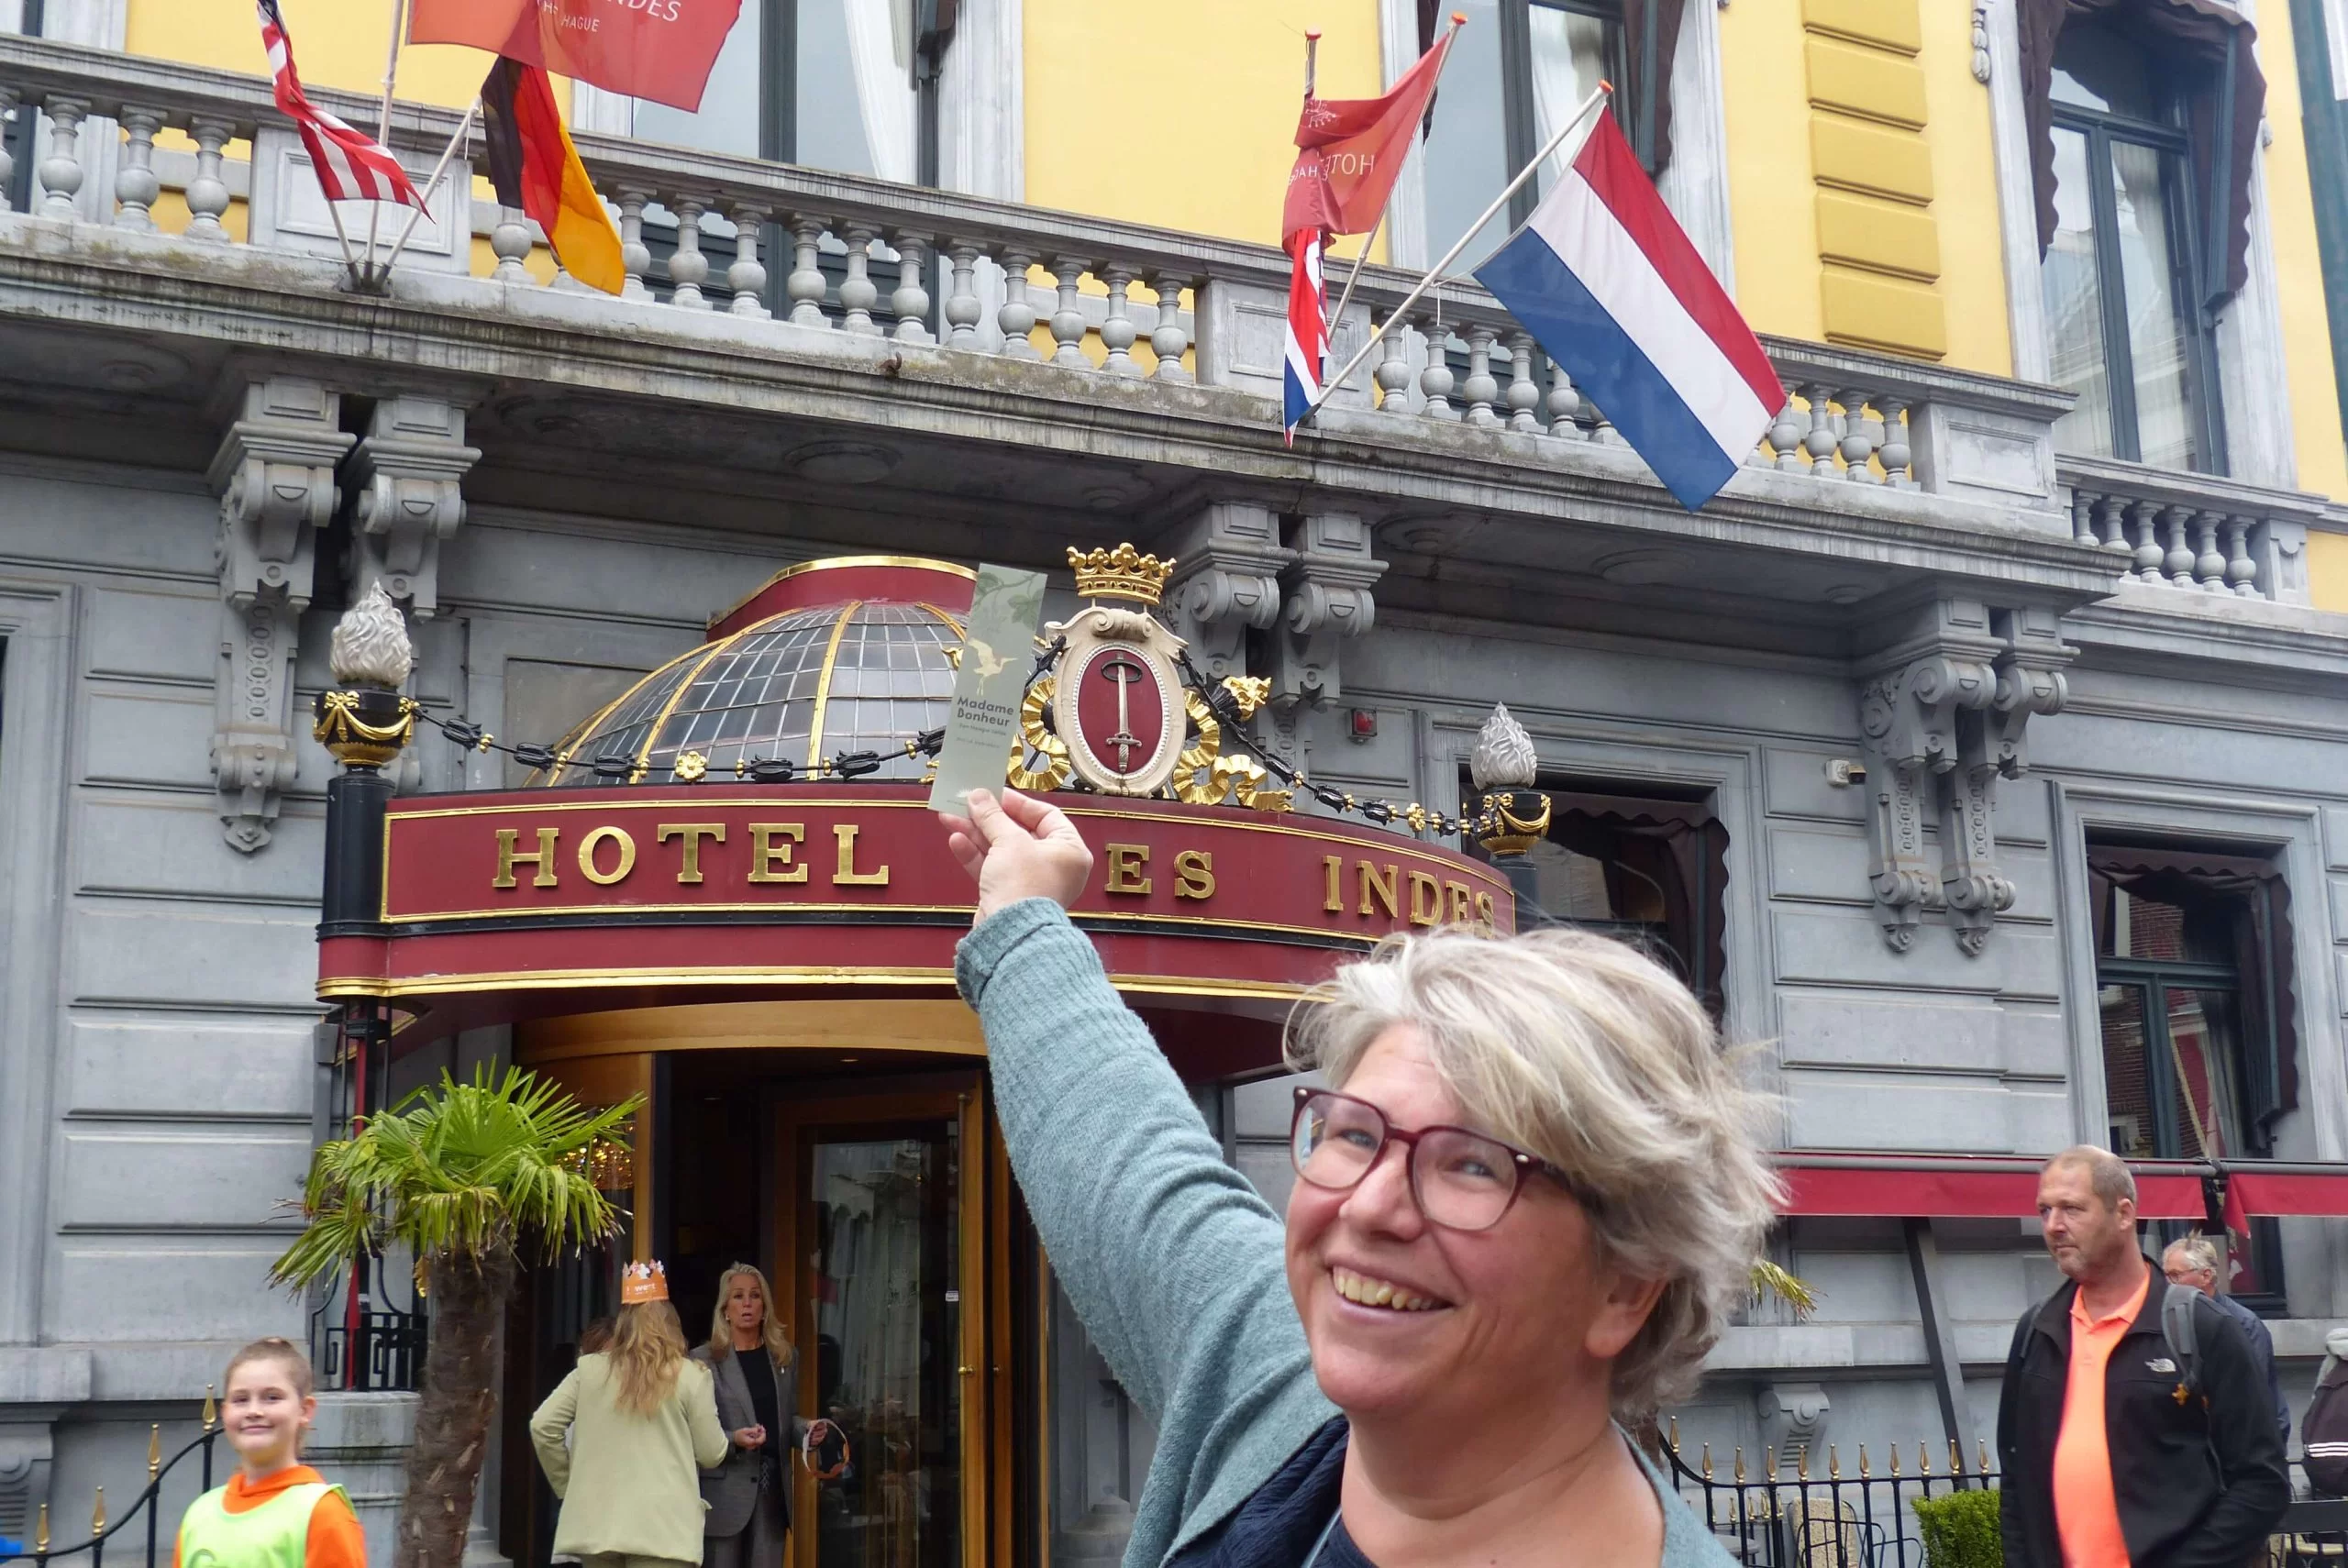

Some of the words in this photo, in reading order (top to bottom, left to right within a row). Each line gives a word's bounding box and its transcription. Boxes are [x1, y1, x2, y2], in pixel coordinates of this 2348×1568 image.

[560, 15, 601, 32] HAGUE
[957, 696, 1013, 715] Madame
[957, 707, 1011, 727] Bonheur
[493, 823, 890, 888] HOTEL
[1104, 843, 1217, 900] ES
[1323, 855, 1494, 939] INDES
